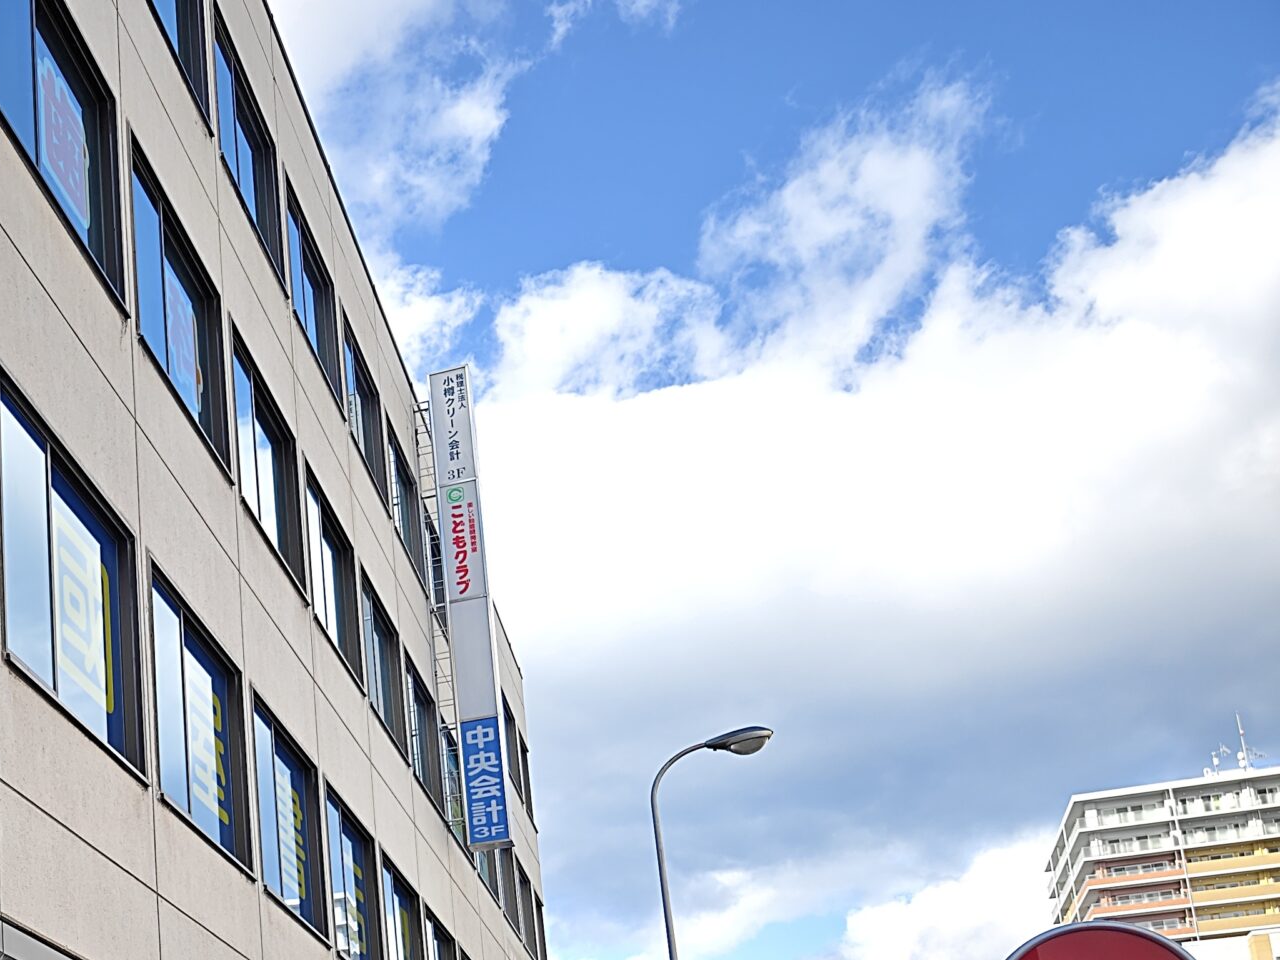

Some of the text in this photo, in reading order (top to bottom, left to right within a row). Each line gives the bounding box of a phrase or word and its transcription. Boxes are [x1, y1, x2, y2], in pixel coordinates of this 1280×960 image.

[442, 375, 461, 461] 小樽クリーン会計
[455, 373, 467, 409] 税理士法人
[447, 467, 466, 480] 3F
[450, 504, 471, 595] こどもクラブ
[465, 725, 503, 825] 中央会計
[473, 825, 505, 838] 3F
